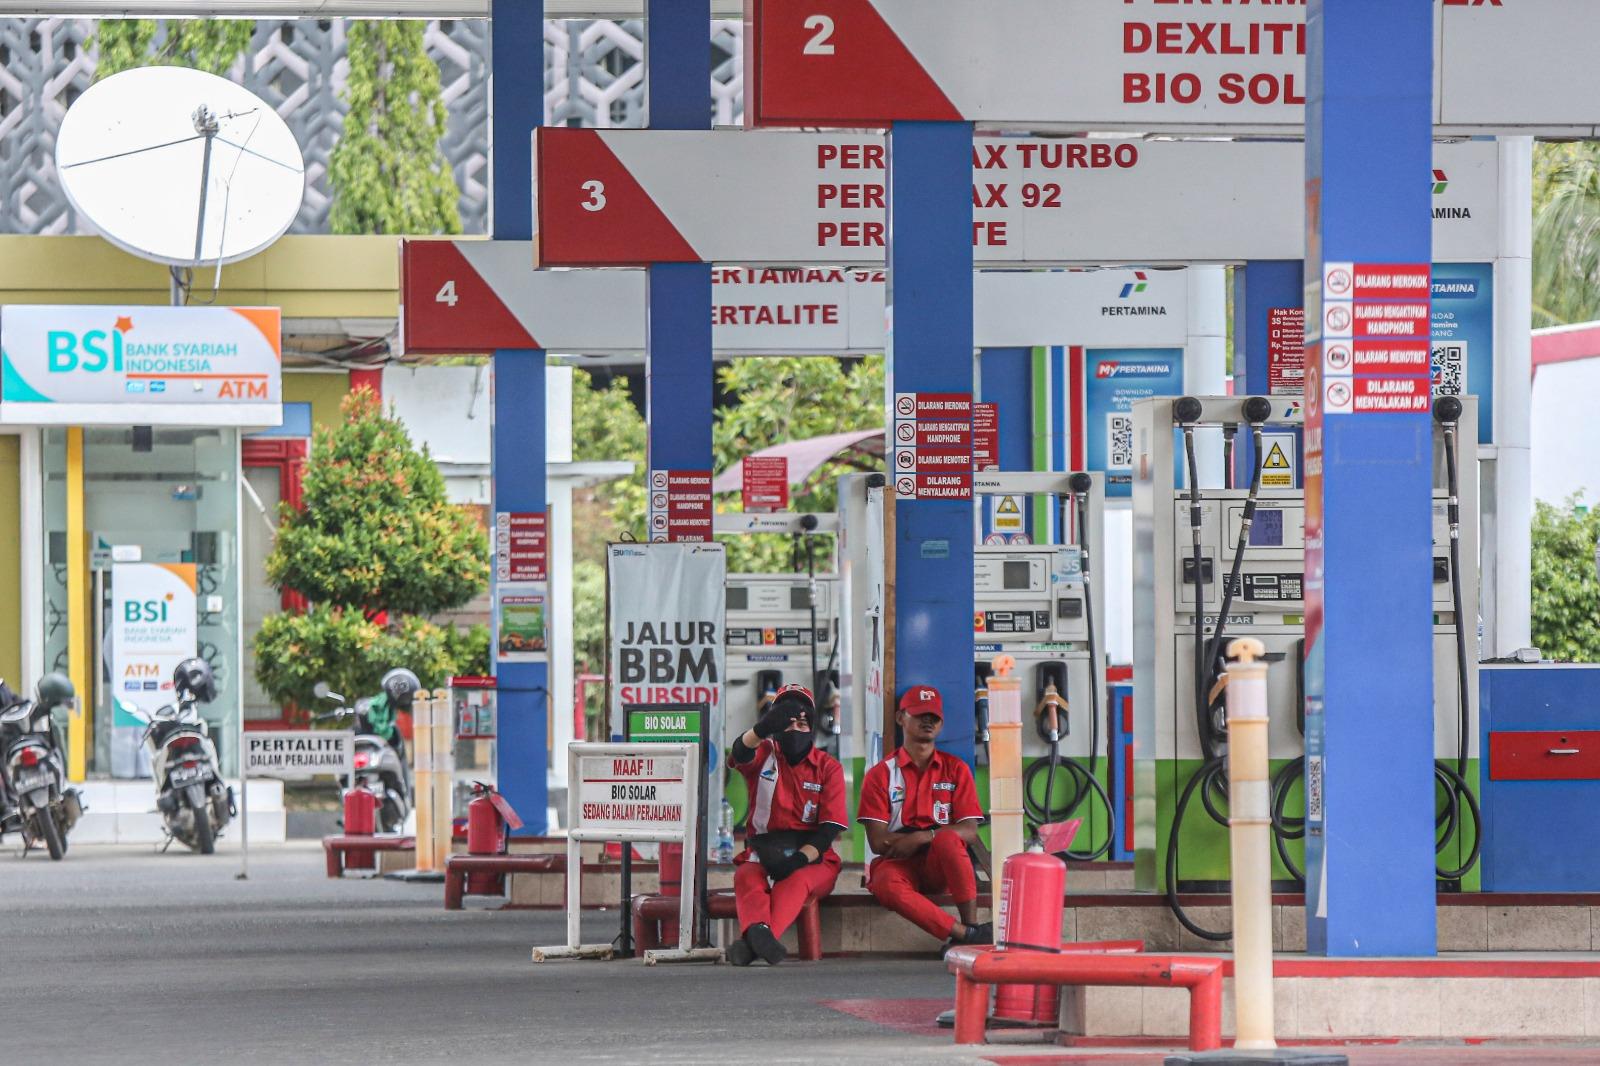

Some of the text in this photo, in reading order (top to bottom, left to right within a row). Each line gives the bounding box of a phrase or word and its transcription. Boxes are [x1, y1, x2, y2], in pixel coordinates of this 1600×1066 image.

[803, 14, 835, 55] 2
[1123, 73, 1306, 104] BIO SOL
[1016, 143, 1138, 168] TURBO
[581, 180, 607, 212] 3
[1022, 183, 1062, 208] 92
[1355, 275, 1428, 289] DILARANG MEROKOK
[435, 280, 459, 307] 4
[712, 304, 838, 324] RTALITE
[1102, 306, 1167, 316] PERTAMINA
[1367, 321, 1415, 335] HANDPHONE
[48, 327, 124, 372] BSI
[126, 343, 237, 356] BANK SYARIAH
[1355, 351, 1389, 364] DILARANG
[126, 359, 212, 372] INDONESIA
[218, 381, 268, 399] ATM
[1367, 380, 1415, 394] DILARANG
[918, 401, 970, 411] DILARANG MEROKOK
[1355, 396, 1428, 410] MENYALAKAN API
[927, 434, 961, 443] HANDPHONE
[918, 455, 970, 464] DILARANG MEMOTRET
[927, 476, 961, 485] DILARANG
[918, 487, 971, 497] MENYALAKAN API
[124, 600, 167, 623] BSI
[620, 621, 717, 646] JALUR
[124, 664, 160, 677] ATM
[620, 648, 718, 684] BBM
[620, 686, 719, 706] SUBSIDI
[644, 716, 687, 730] BIO SOLAR
[250, 739, 344, 751] PERTALITE
[250, 753, 345, 766] DALAM PERJALANAN
[613, 759, 654, 776] MAAF !!
[611, 784, 656, 801] BIO SOLAR
[583, 803, 682, 822] SEDANG DALAM PERJALANAN
